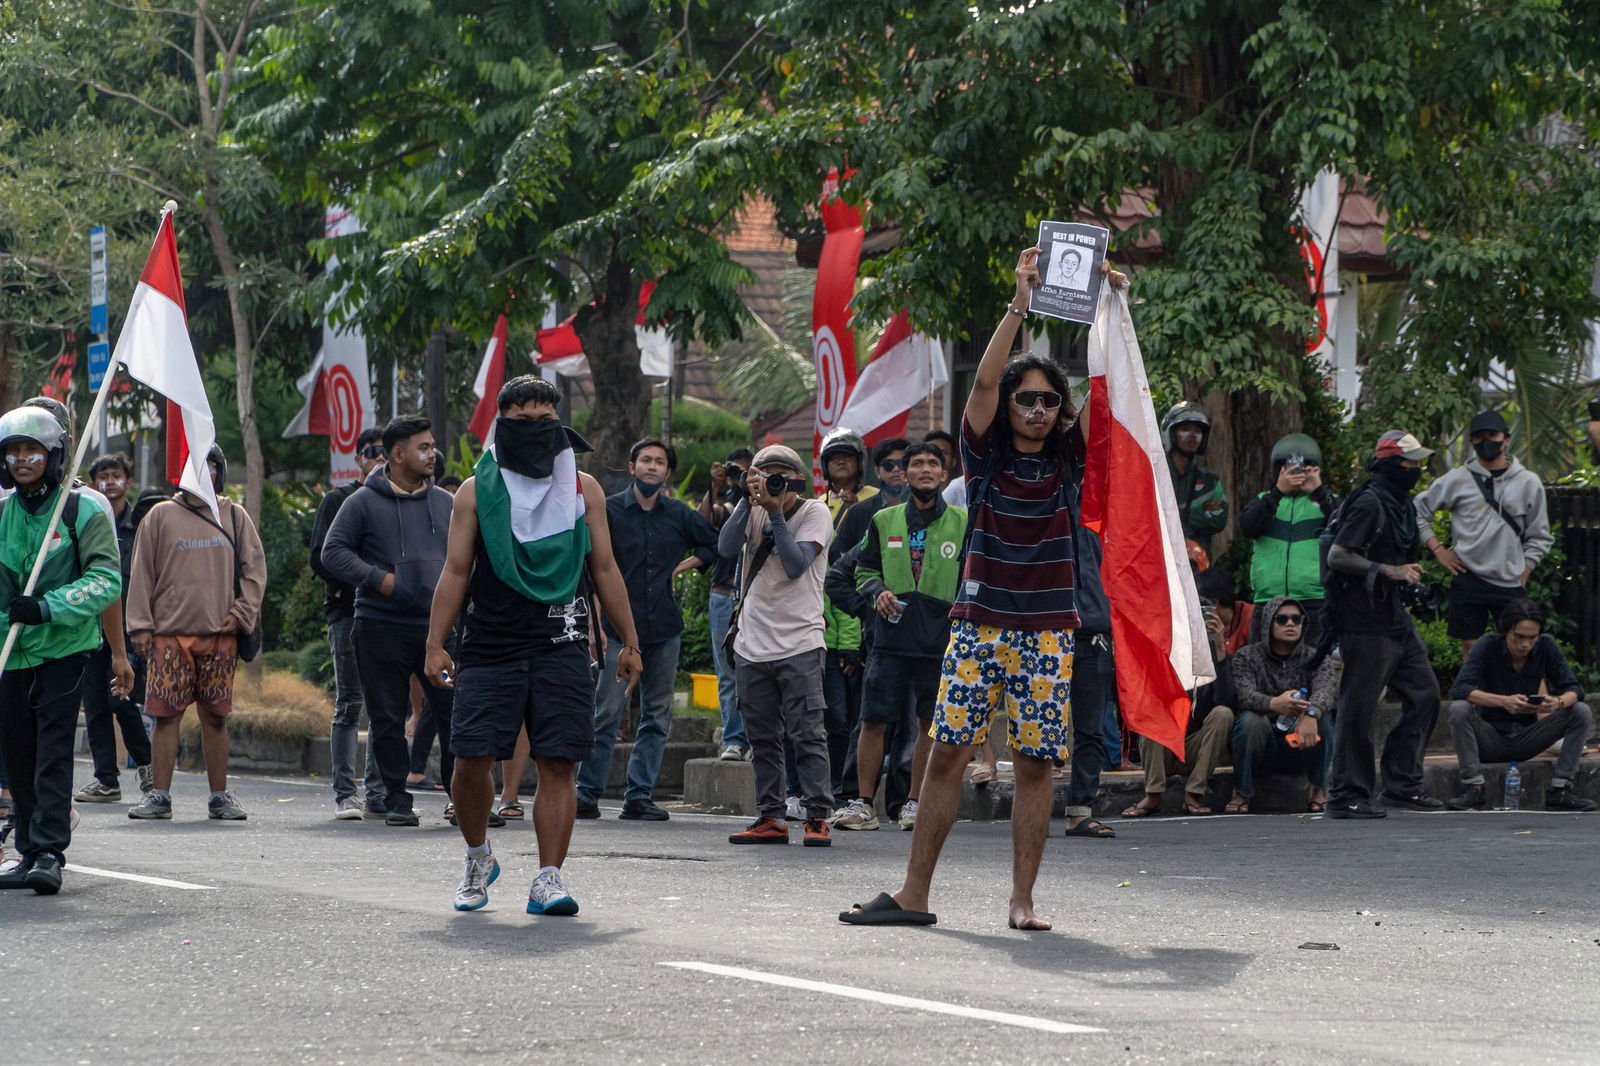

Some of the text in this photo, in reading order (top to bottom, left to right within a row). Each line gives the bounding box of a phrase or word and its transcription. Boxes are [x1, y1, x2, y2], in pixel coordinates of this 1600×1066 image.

[1053, 232, 1096, 246] REST IN POWER
[66, 576, 112, 605] Grab
